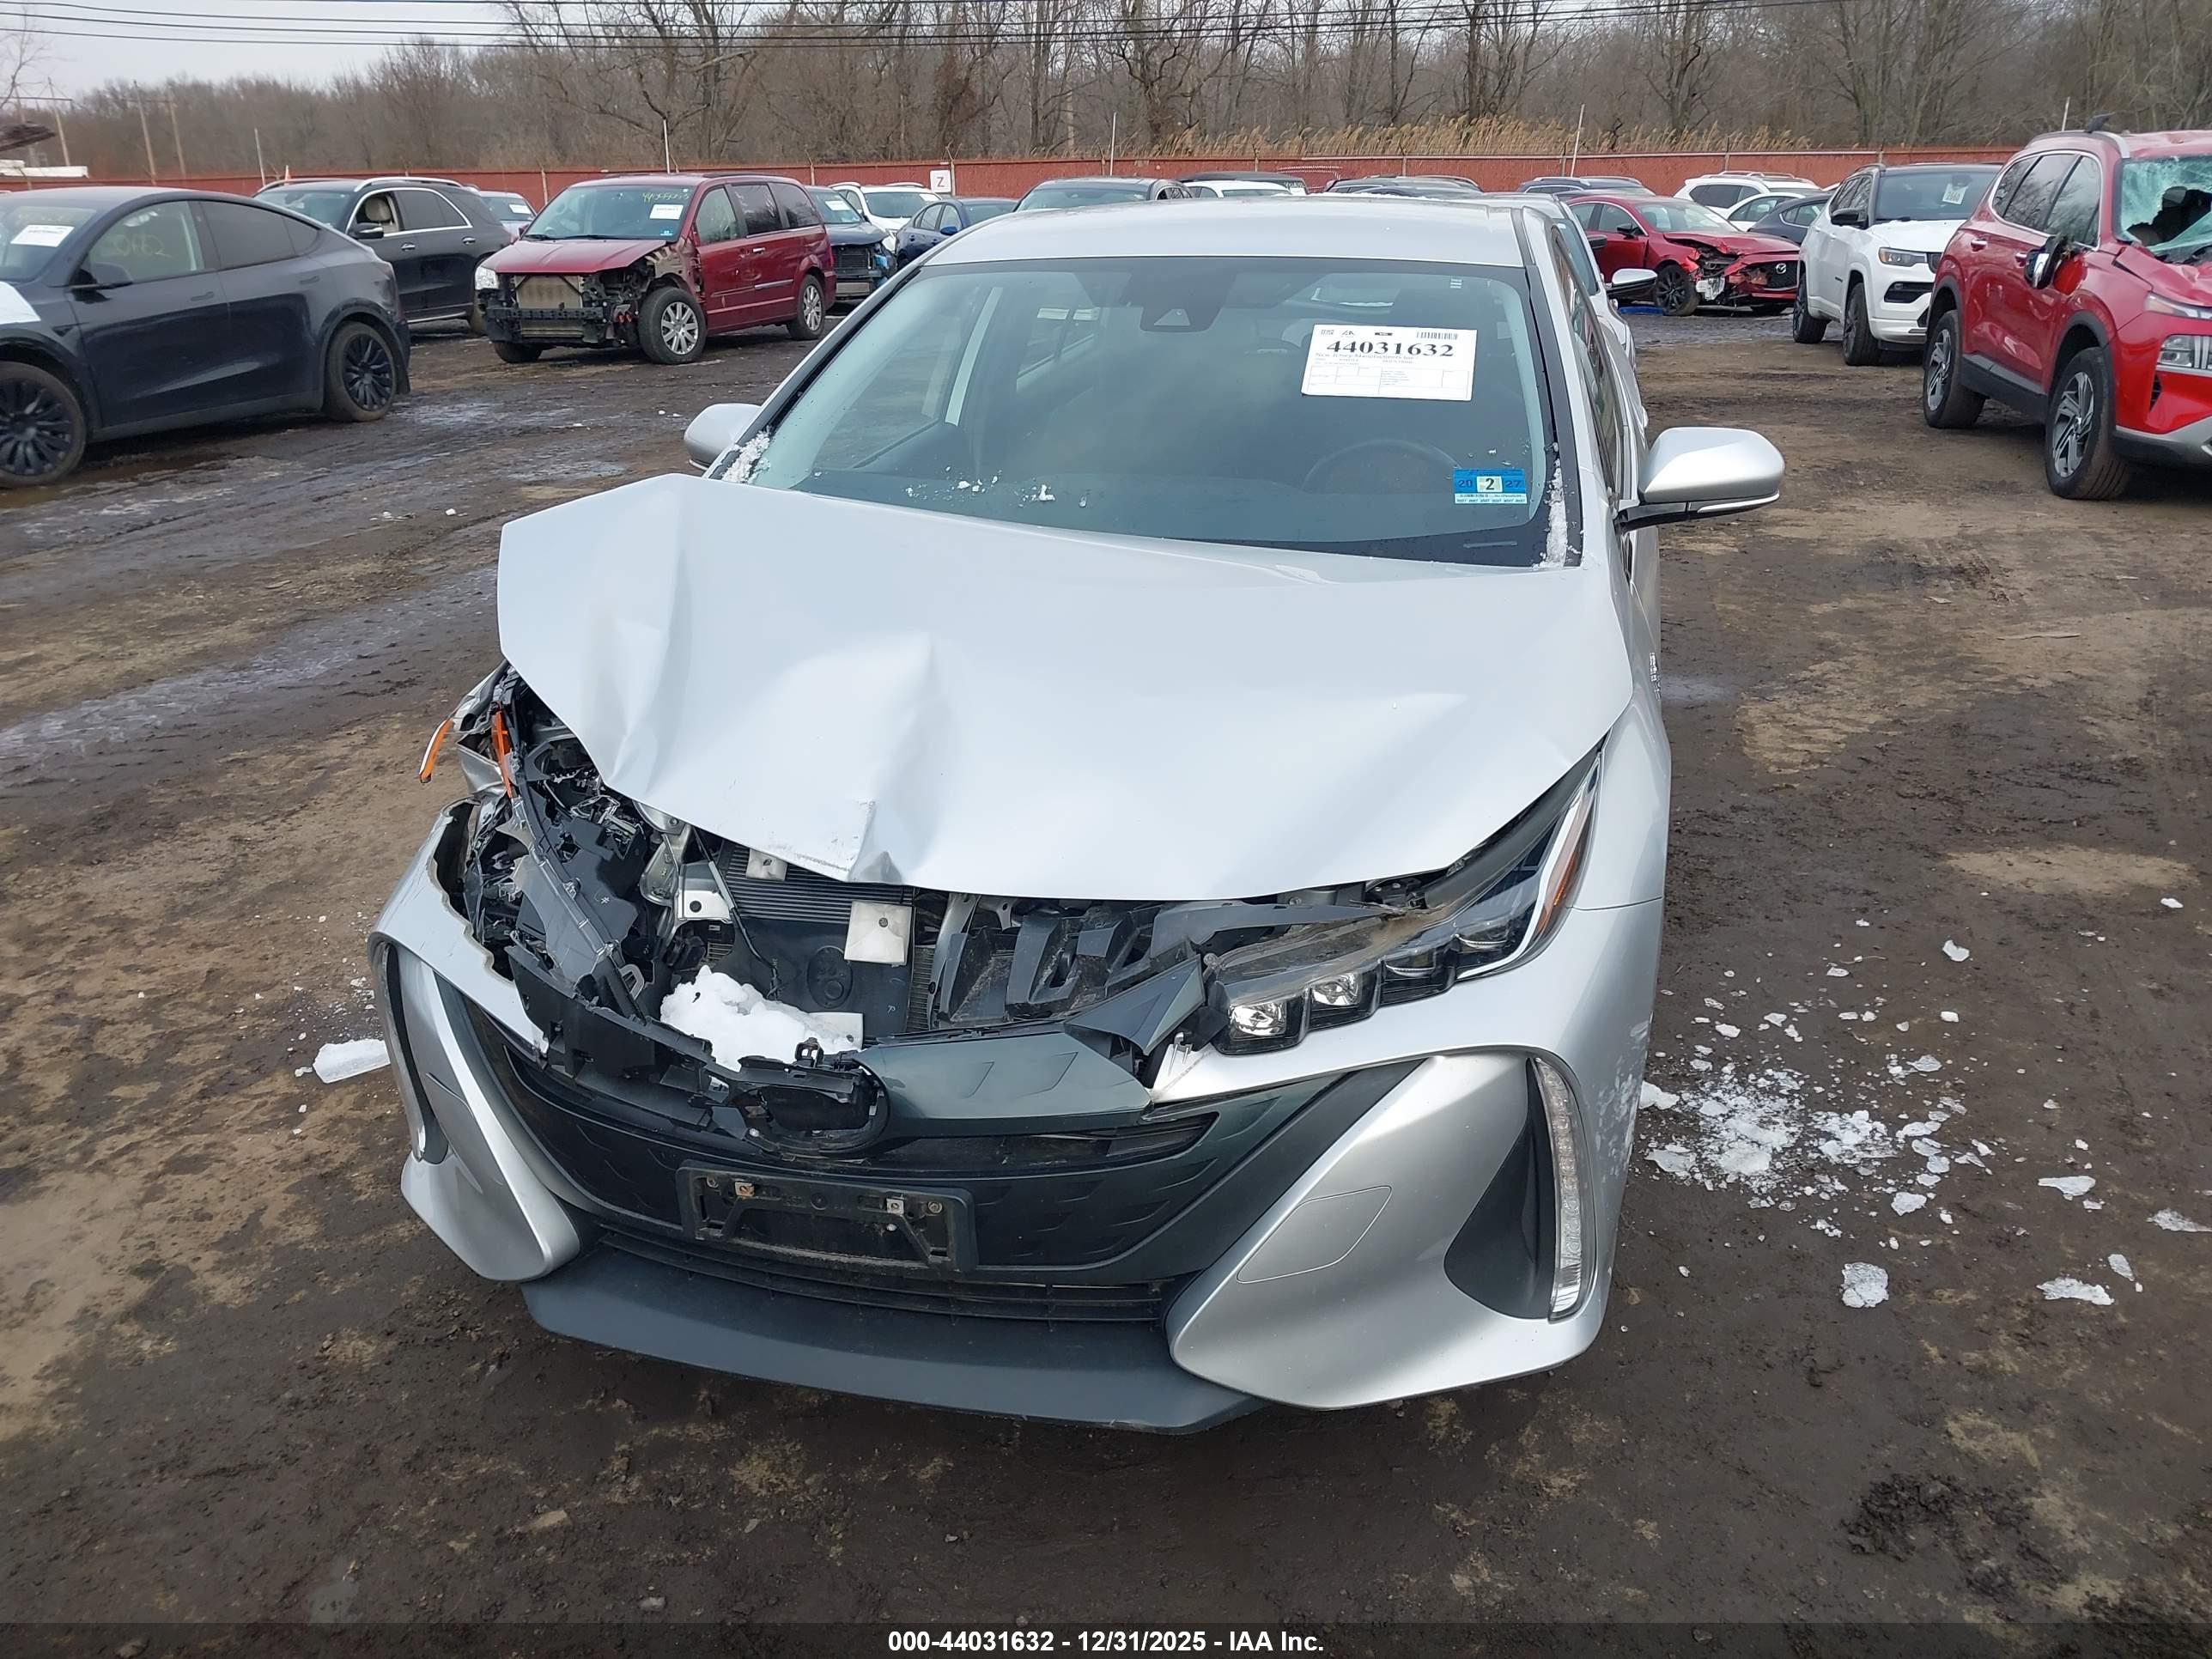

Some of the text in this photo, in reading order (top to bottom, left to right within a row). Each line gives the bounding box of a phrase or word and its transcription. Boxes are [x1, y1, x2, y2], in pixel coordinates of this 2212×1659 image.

[937, 177, 945, 187] Z
[1327, 340, 1454, 357] 44031632
[1486, 477, 1495, 490] 2
